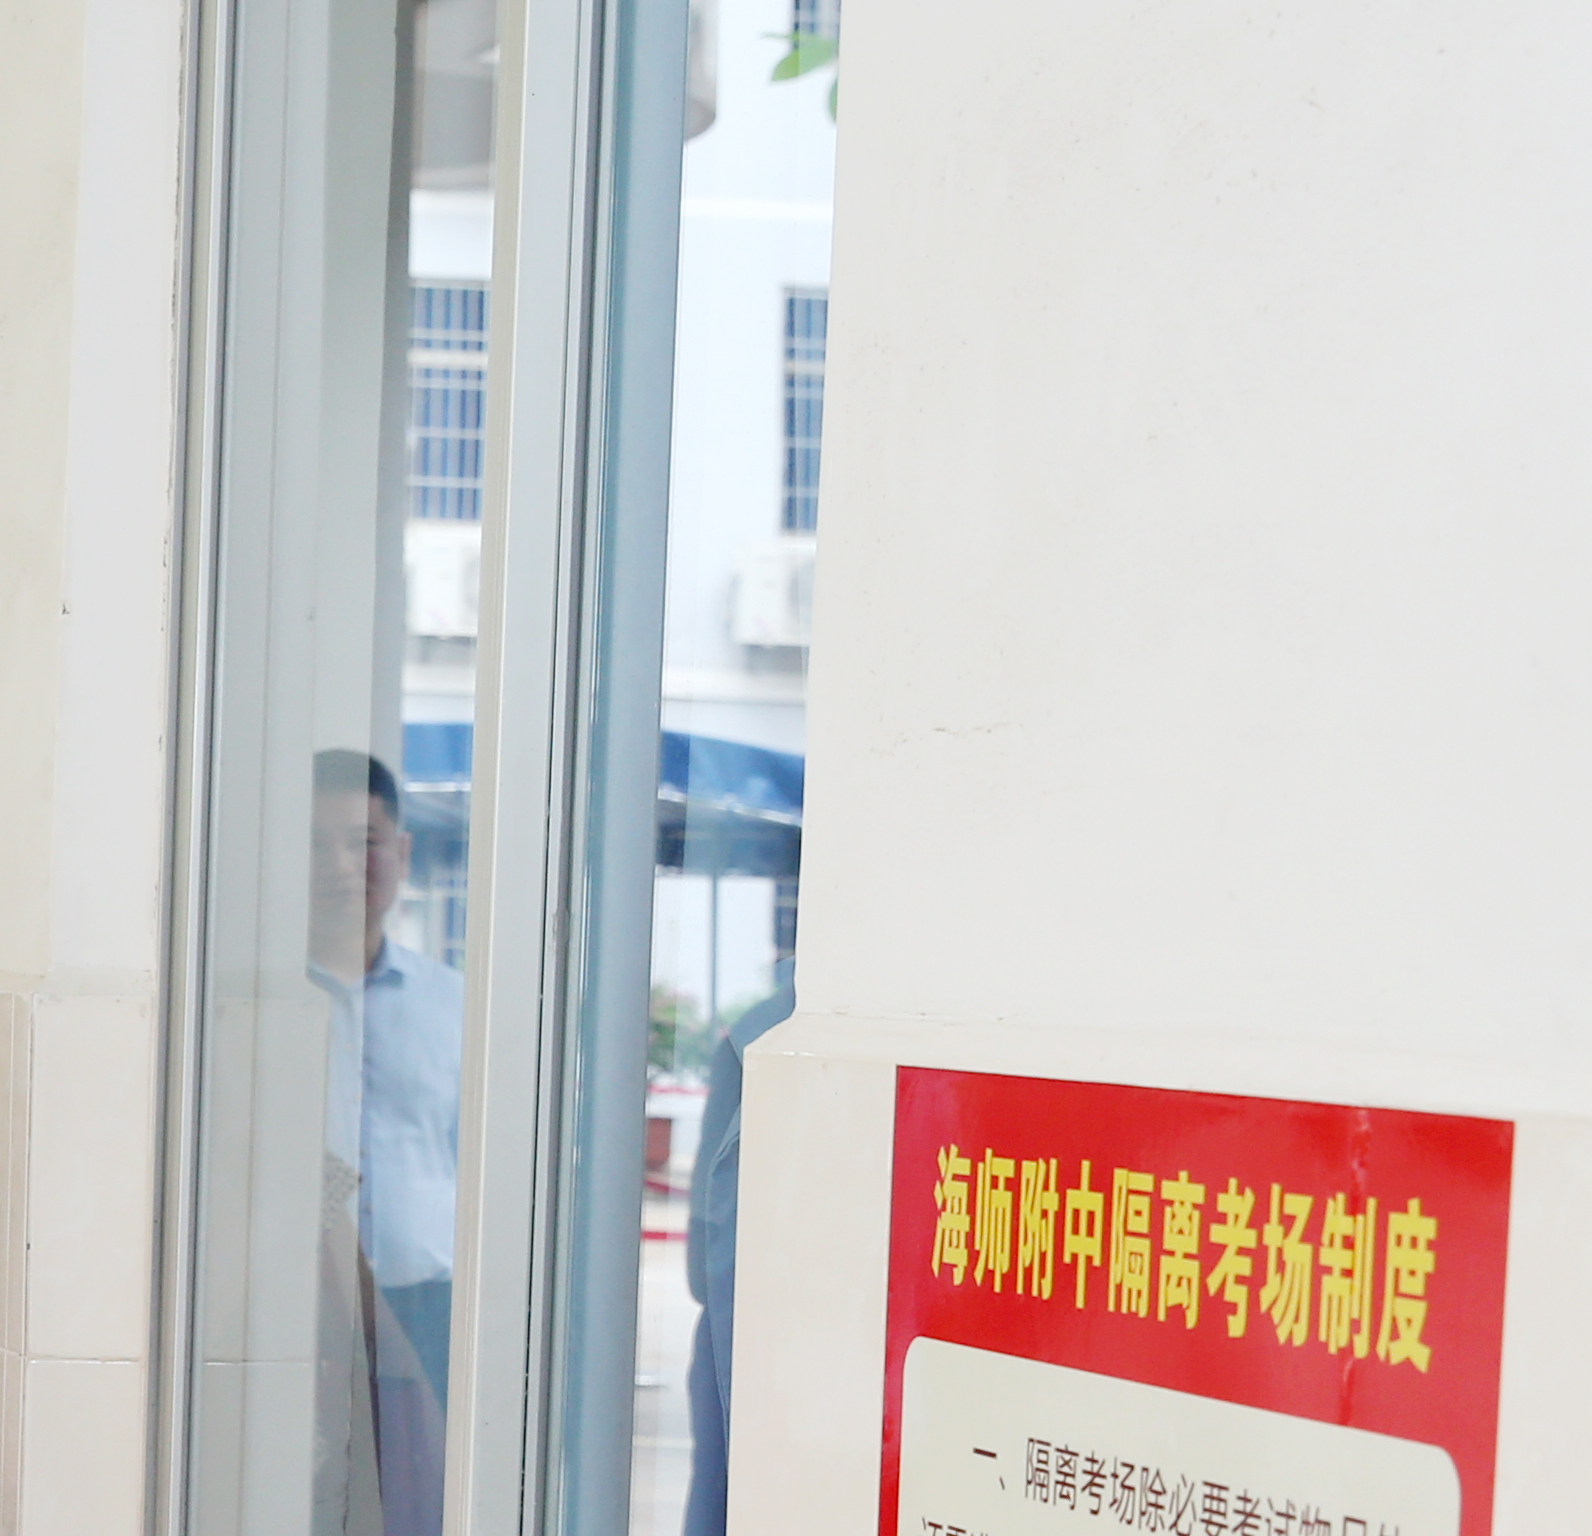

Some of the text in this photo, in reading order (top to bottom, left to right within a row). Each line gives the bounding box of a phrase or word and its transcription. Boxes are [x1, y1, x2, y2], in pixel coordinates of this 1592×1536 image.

[931, 1143, 1438, 1373] 海师附中隔离考场制度
